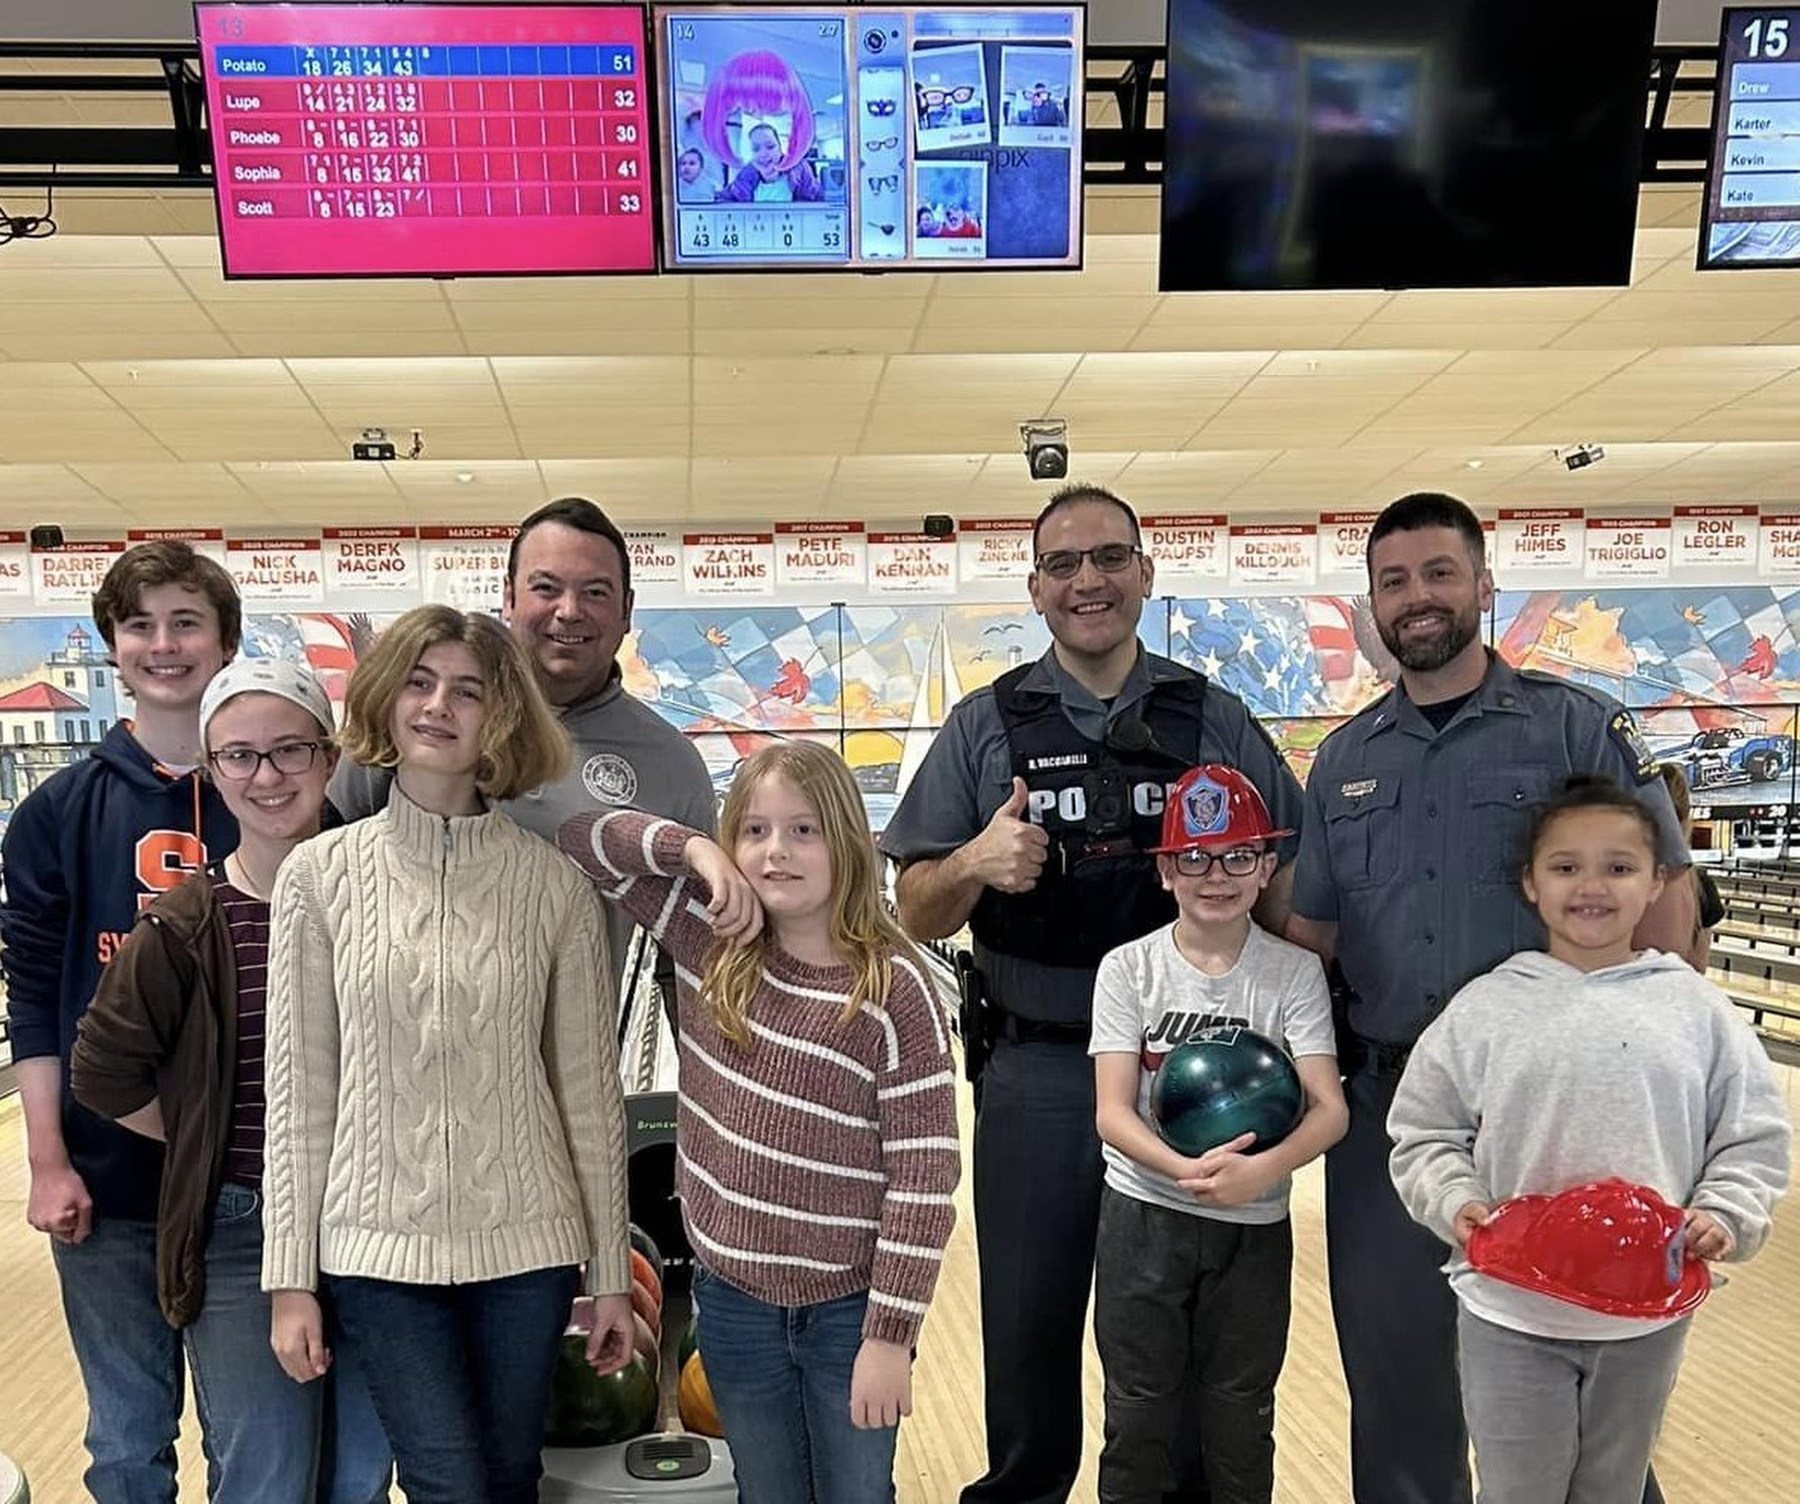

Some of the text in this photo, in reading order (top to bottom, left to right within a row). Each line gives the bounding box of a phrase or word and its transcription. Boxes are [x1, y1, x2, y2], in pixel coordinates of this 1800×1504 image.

[1743, 19, 1789, 58] 15
[222, 56, 632, 76] Potato 18 26 34 43 51
[1738, 80, 1771, 95] Drew
[225, 91, 636, 112] Lupe 14 21 24 32 32
[1734, 117, 1771, 131] Karter
[230, 126, 637, 148] Phoebe 8 16 22 30 30
[1730, 153, 1765, 167] Kevin
[234, 165, 281, 181] Sophia
[317, 167, 328, 183] 8
[372, 167, 392, 183] 32
[402, 167, 420, 183] 41
[618, 160, 638, 177] 41
[1727, 190, 1754, 202] Kate
[237, 200, 273, 215] Scott
[320, 202, 331, 218] 8
[376, 201, 395, 217] 23
[620, 194, 640, 211] 33
[692, 232, 840, 247] 43 48 0 53
[1520, 523, 1561, 538] JEFF
[1697, 520, 1734, 534] RON
[799, 537, 843, 551] PETE
[1152, 530, 1216, 546] DUSTIN
[1514, 538, 1567, 552] HIMES
[1613, 532, 1644, 546] JOE
[1683, 534, 1746, 549] LEGLER
[705, 549, 753, 563] ZACH
[1244, 542, 1302, 555] DENNIS
[1587, 546, 1667, 561] TRIGIGLIO
[43, 557, 109, 572] DARRE
[252, 554, 297, 571] NICK
[338, 558, 406, 573] MAGNO
[786, 552, 856, 567] MADURI
[234, 570, 320, 586] GALUSHA
[693, 564, 767, 579] WILKINS
